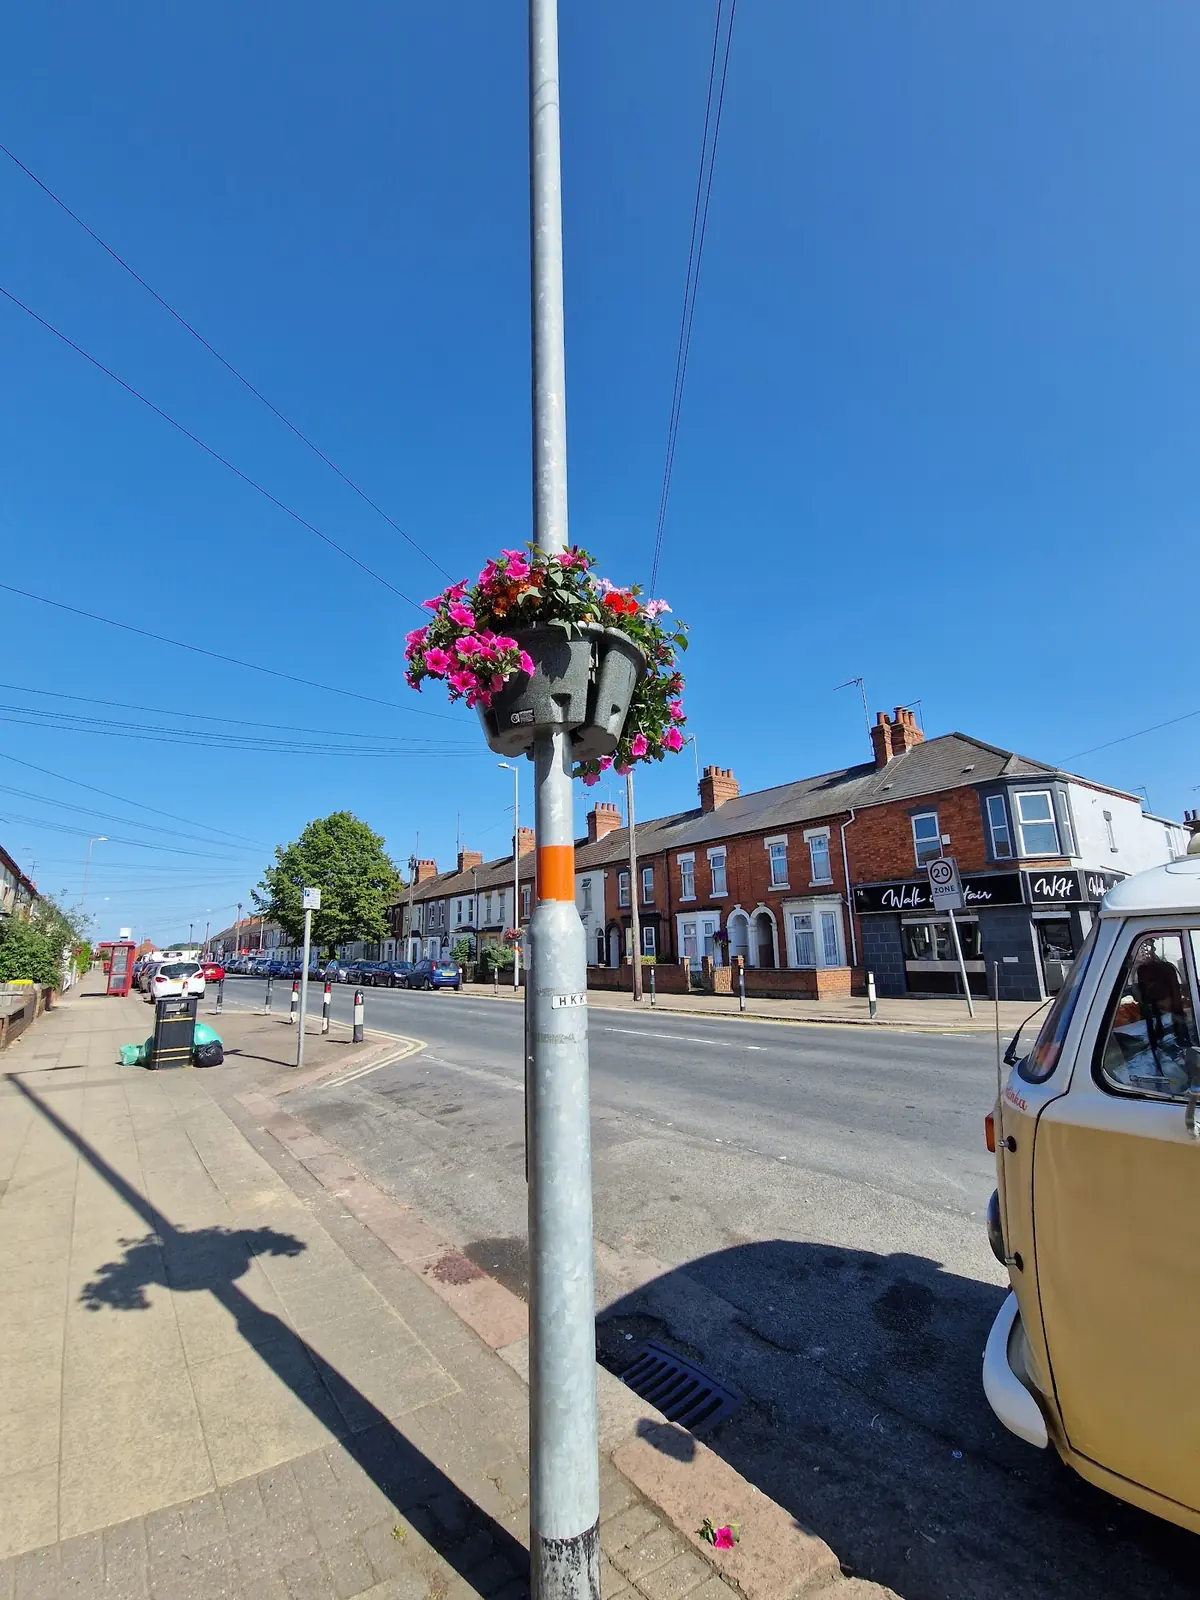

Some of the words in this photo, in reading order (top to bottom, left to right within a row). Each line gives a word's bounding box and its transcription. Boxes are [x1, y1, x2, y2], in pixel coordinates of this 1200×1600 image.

[933, 866, 949, 878] 20
[934, 885, 955, 894] ZONE
[881, 885, 926, 908] Walk
